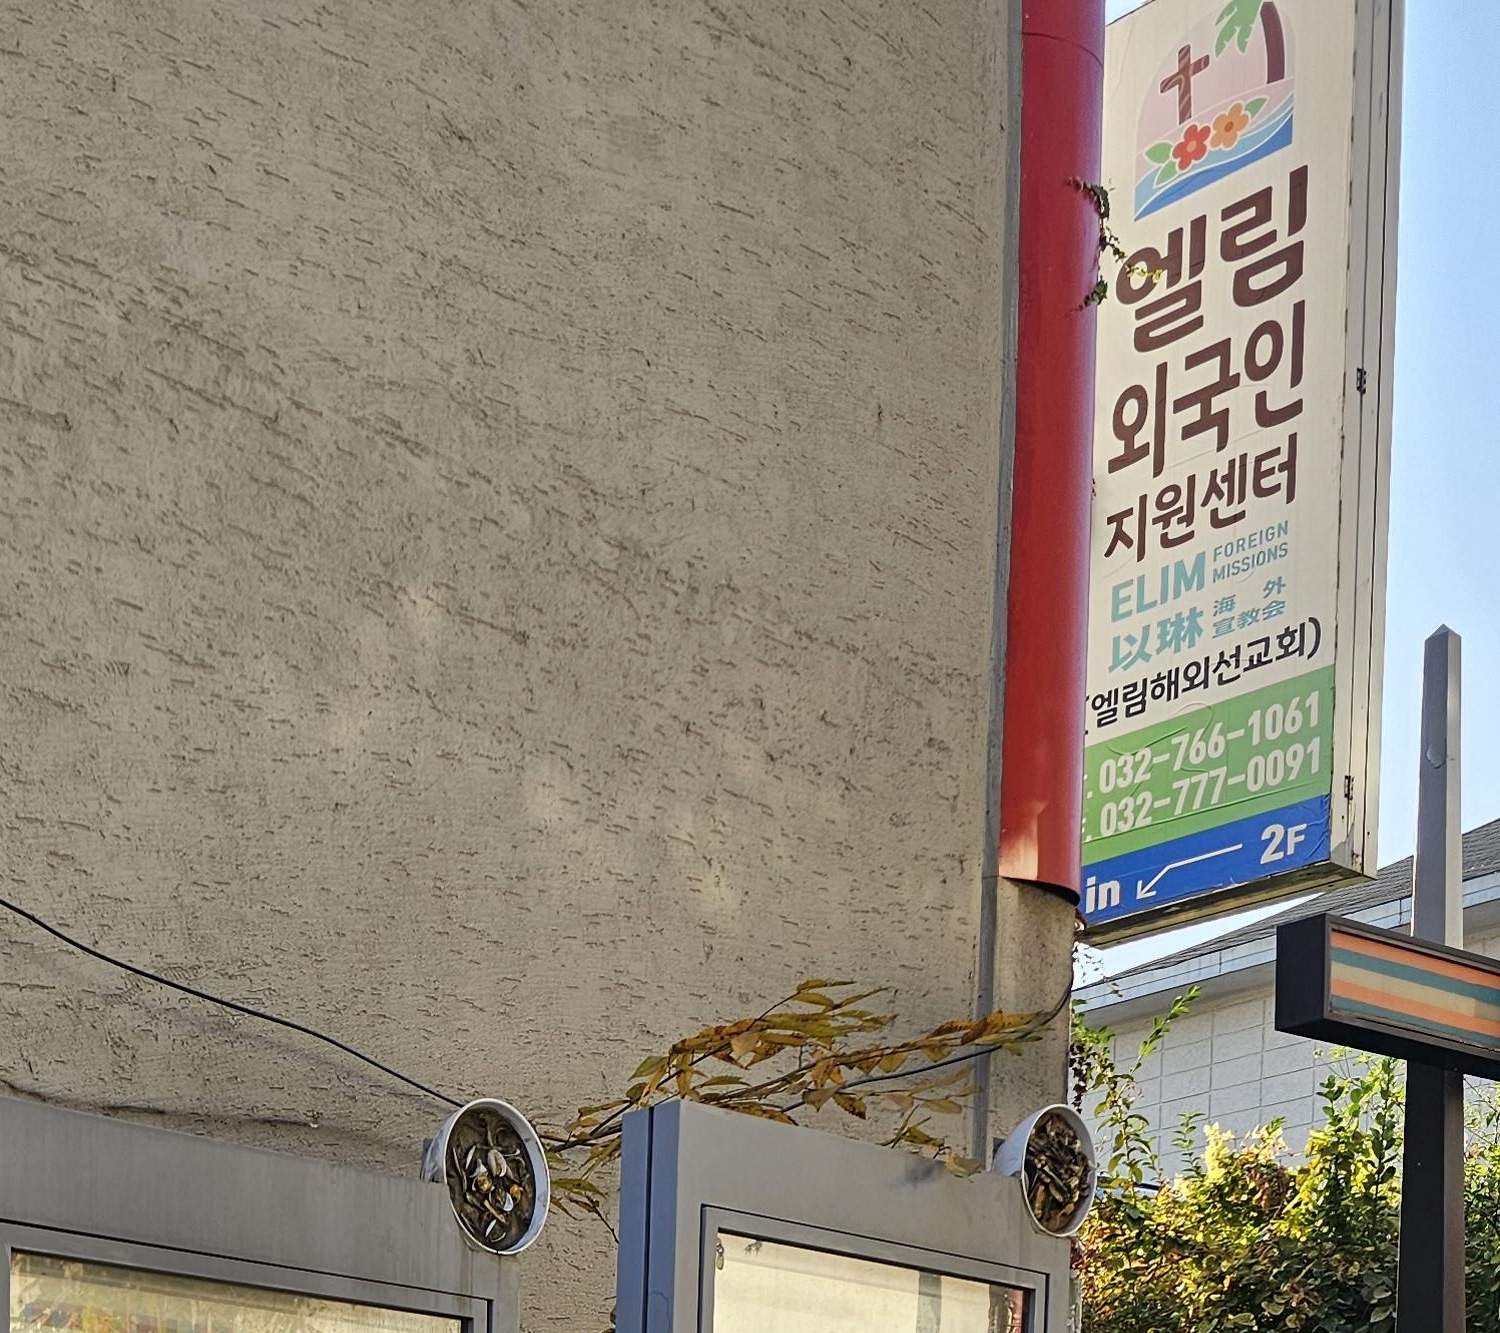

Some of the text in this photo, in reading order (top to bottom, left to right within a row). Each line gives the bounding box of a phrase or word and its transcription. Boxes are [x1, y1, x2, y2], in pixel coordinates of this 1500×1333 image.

[1116, 165, 1308, 353] 엘림
[1108, 299, 1306, 479] 외국인
[1104, 432, 1298, 562] 지원센터
[1212, 542, 1289, 583] MISSIONS
[1213, 521, 1289, 562] FOREIGN
[1110, 551, 1206, 623] ELIM
[1212, 599, 1286, 638] 宣教会
[1108, 606, 1204, 674] 以琳
[1099, 690, 1320, 795] 032-766-1061
[1100, 737, 1320, 838] 032-777-0091
[1260, 823, 1308, 865] 2F
